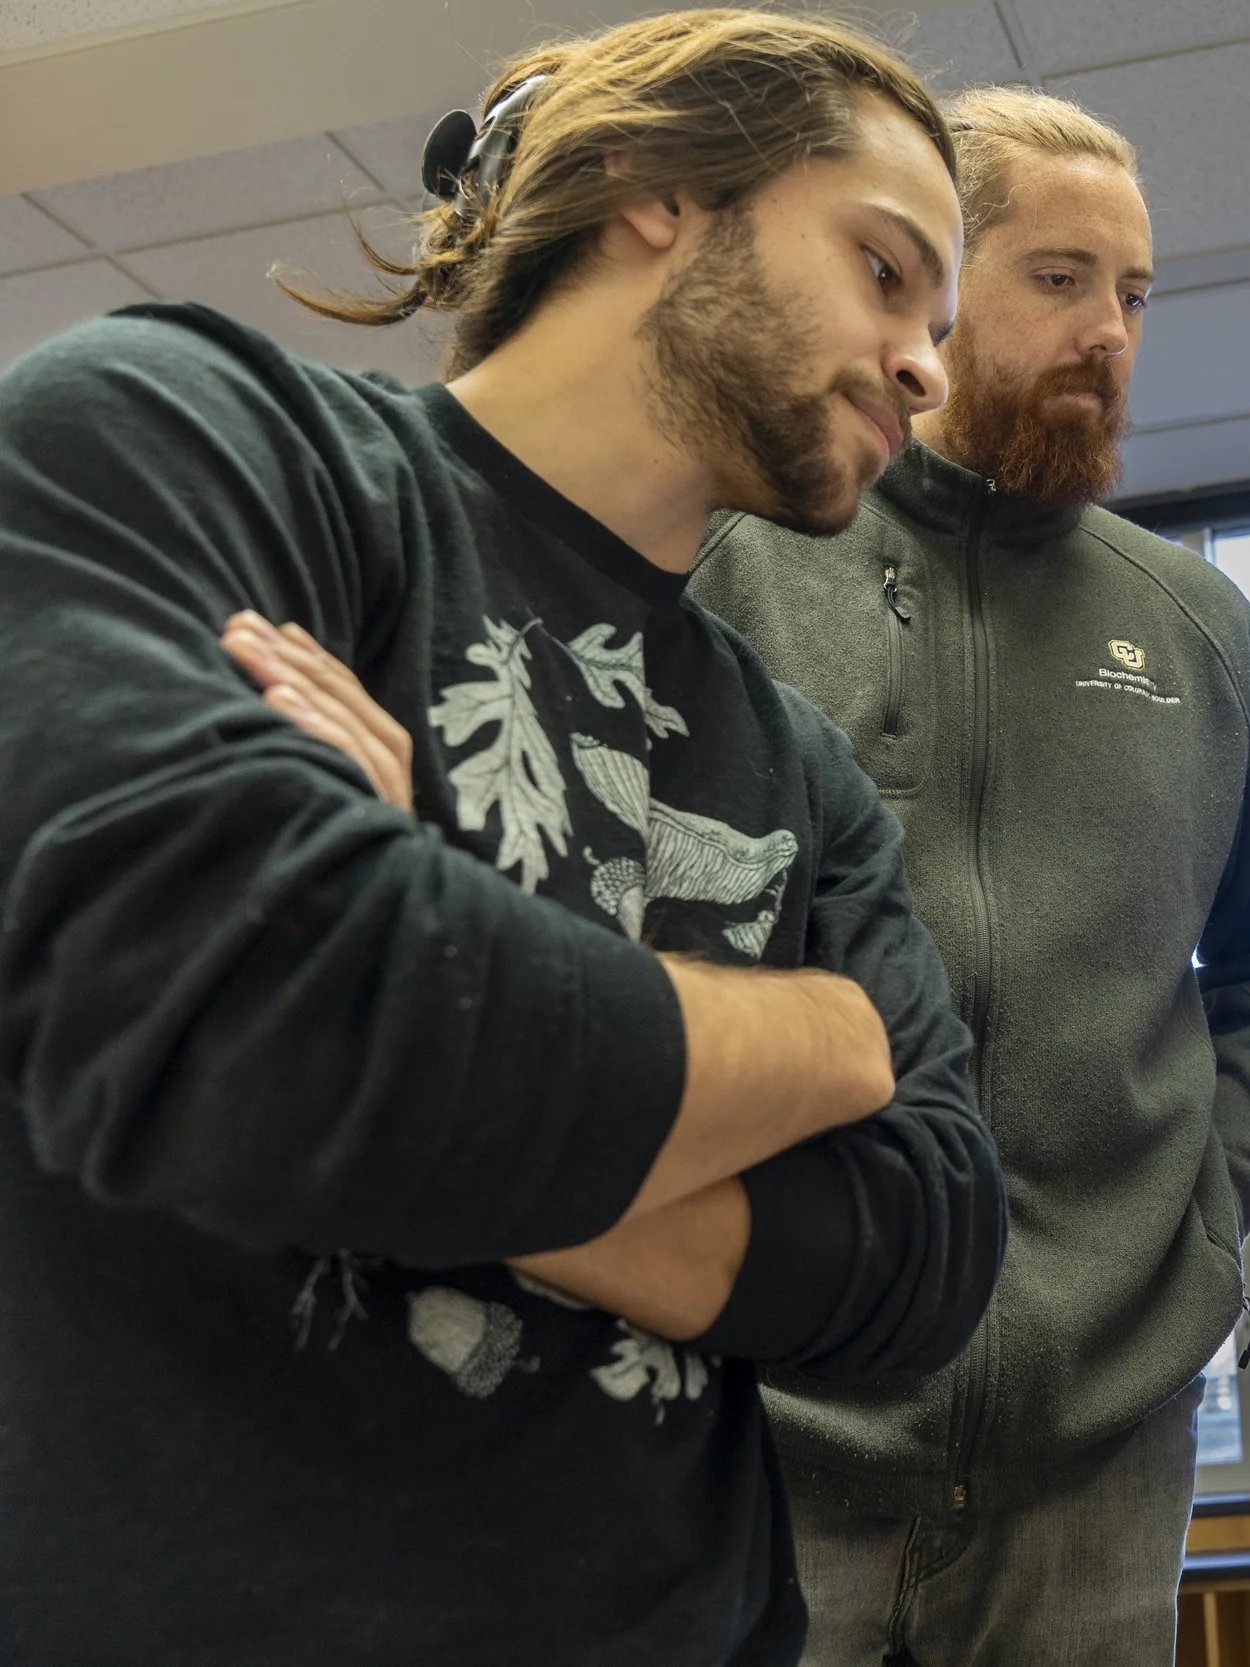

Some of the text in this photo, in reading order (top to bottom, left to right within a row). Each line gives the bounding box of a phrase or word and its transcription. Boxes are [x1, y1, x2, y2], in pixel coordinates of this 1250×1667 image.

[1108, 639, 1145, 671] CU
[1099, 668, 1157, 691] Biochemisy
[1075, 680, 1112, 689] UNIVERSITY
[1114, 682, 1122, 690] OF
[1151, 694, 1181, 704] BOULDER
